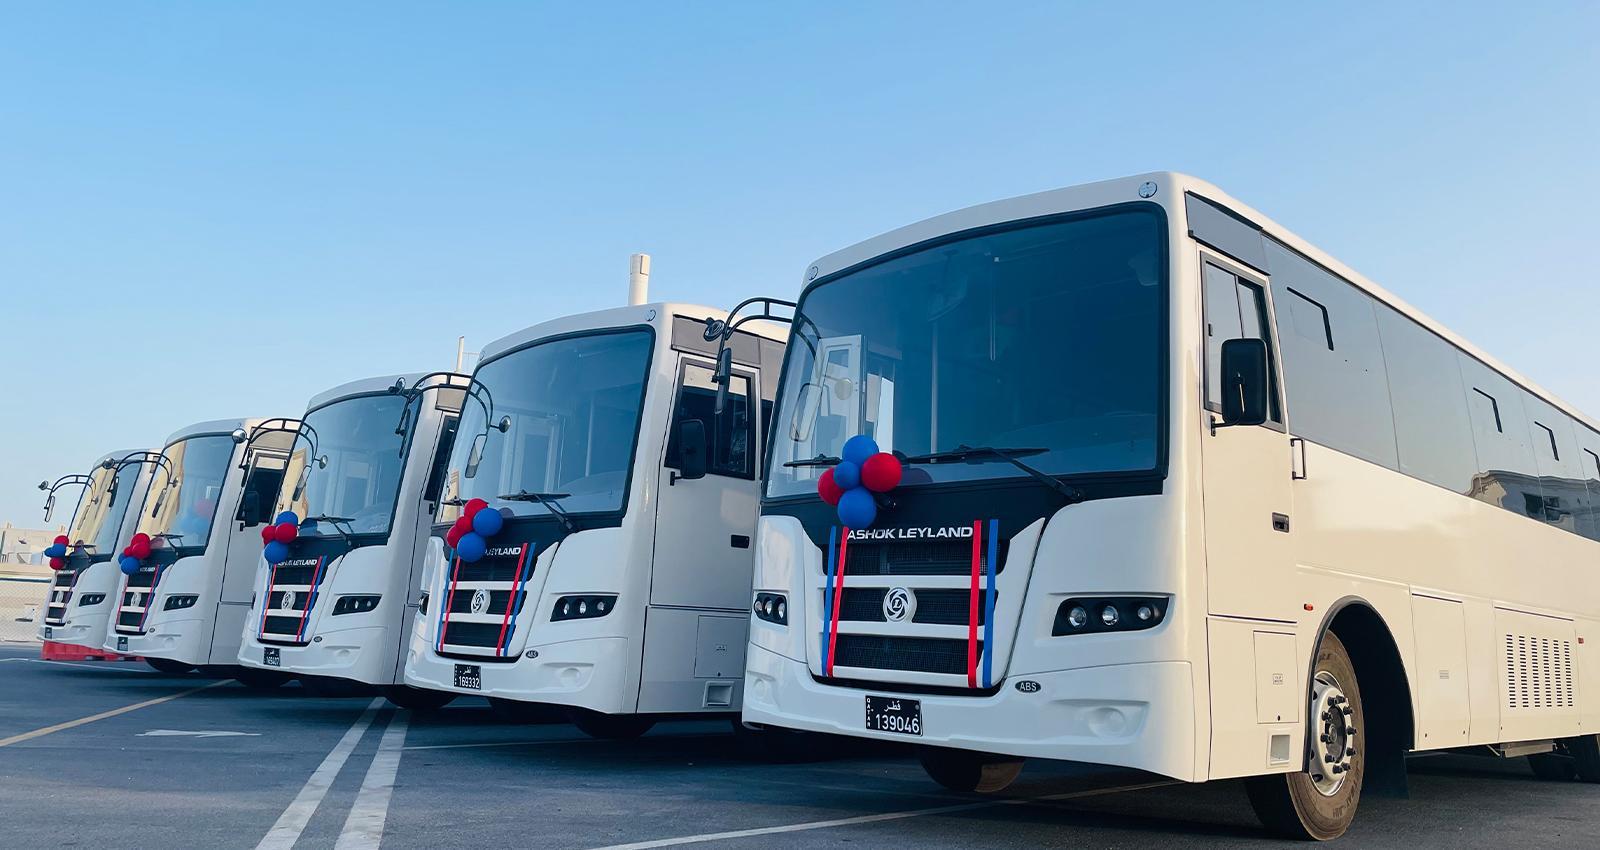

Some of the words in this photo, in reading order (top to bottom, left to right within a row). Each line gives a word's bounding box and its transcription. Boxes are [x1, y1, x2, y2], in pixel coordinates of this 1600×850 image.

[847, 528, 896, 540] ASHOK
[898, 526, 974, 539] LEYLAND
[459, 675, 480, 689] 169332
[1019, 682, 1037, 692] ABS
[883, 700, 901, 712] قطر
[875, 713, 920, 733] 139046
